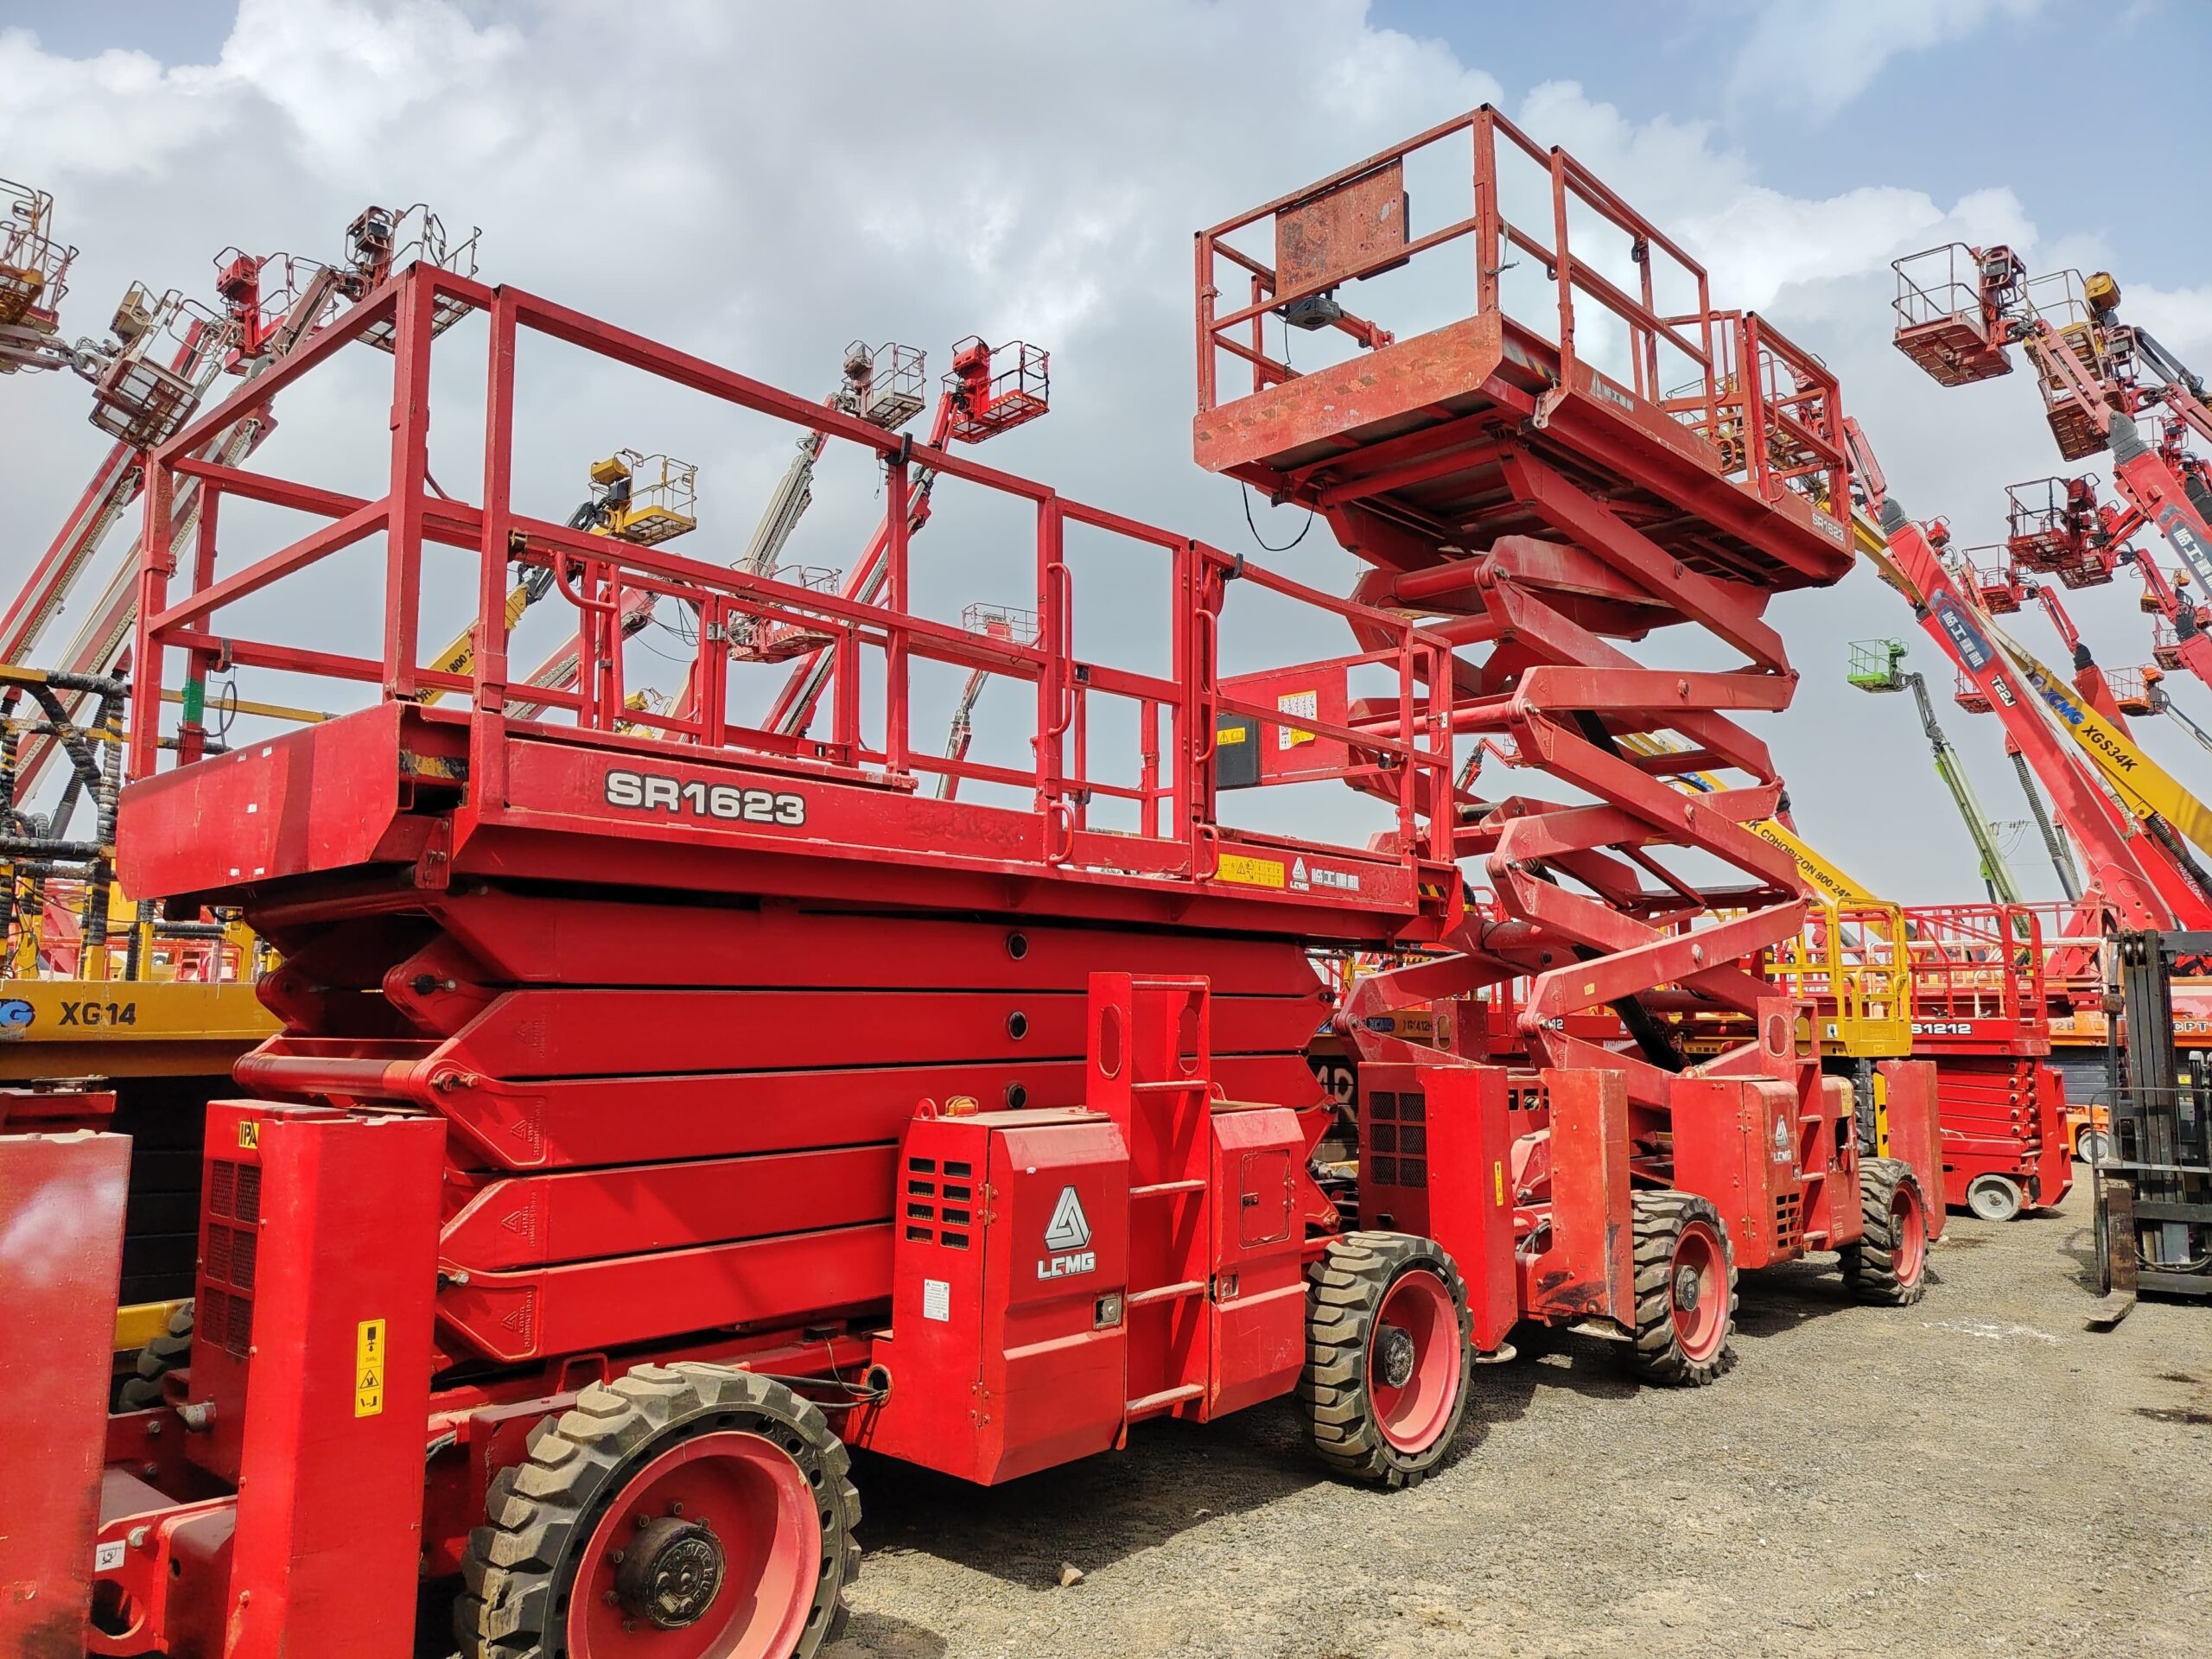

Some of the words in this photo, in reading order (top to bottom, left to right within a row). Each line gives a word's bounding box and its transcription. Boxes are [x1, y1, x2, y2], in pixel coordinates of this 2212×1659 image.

[1812, 512, 1844, 543] SR1623
[1990, 674, 2017, 707] T22J
[2081, 724, 2139, 772] XGS34K
[606, 770, 806, 827] SR1623
[1815, 870, 1834, 888] 800
[58, 1001, 137, 1026] XG14
[1911, 1023, 1972, 1034] S1212
